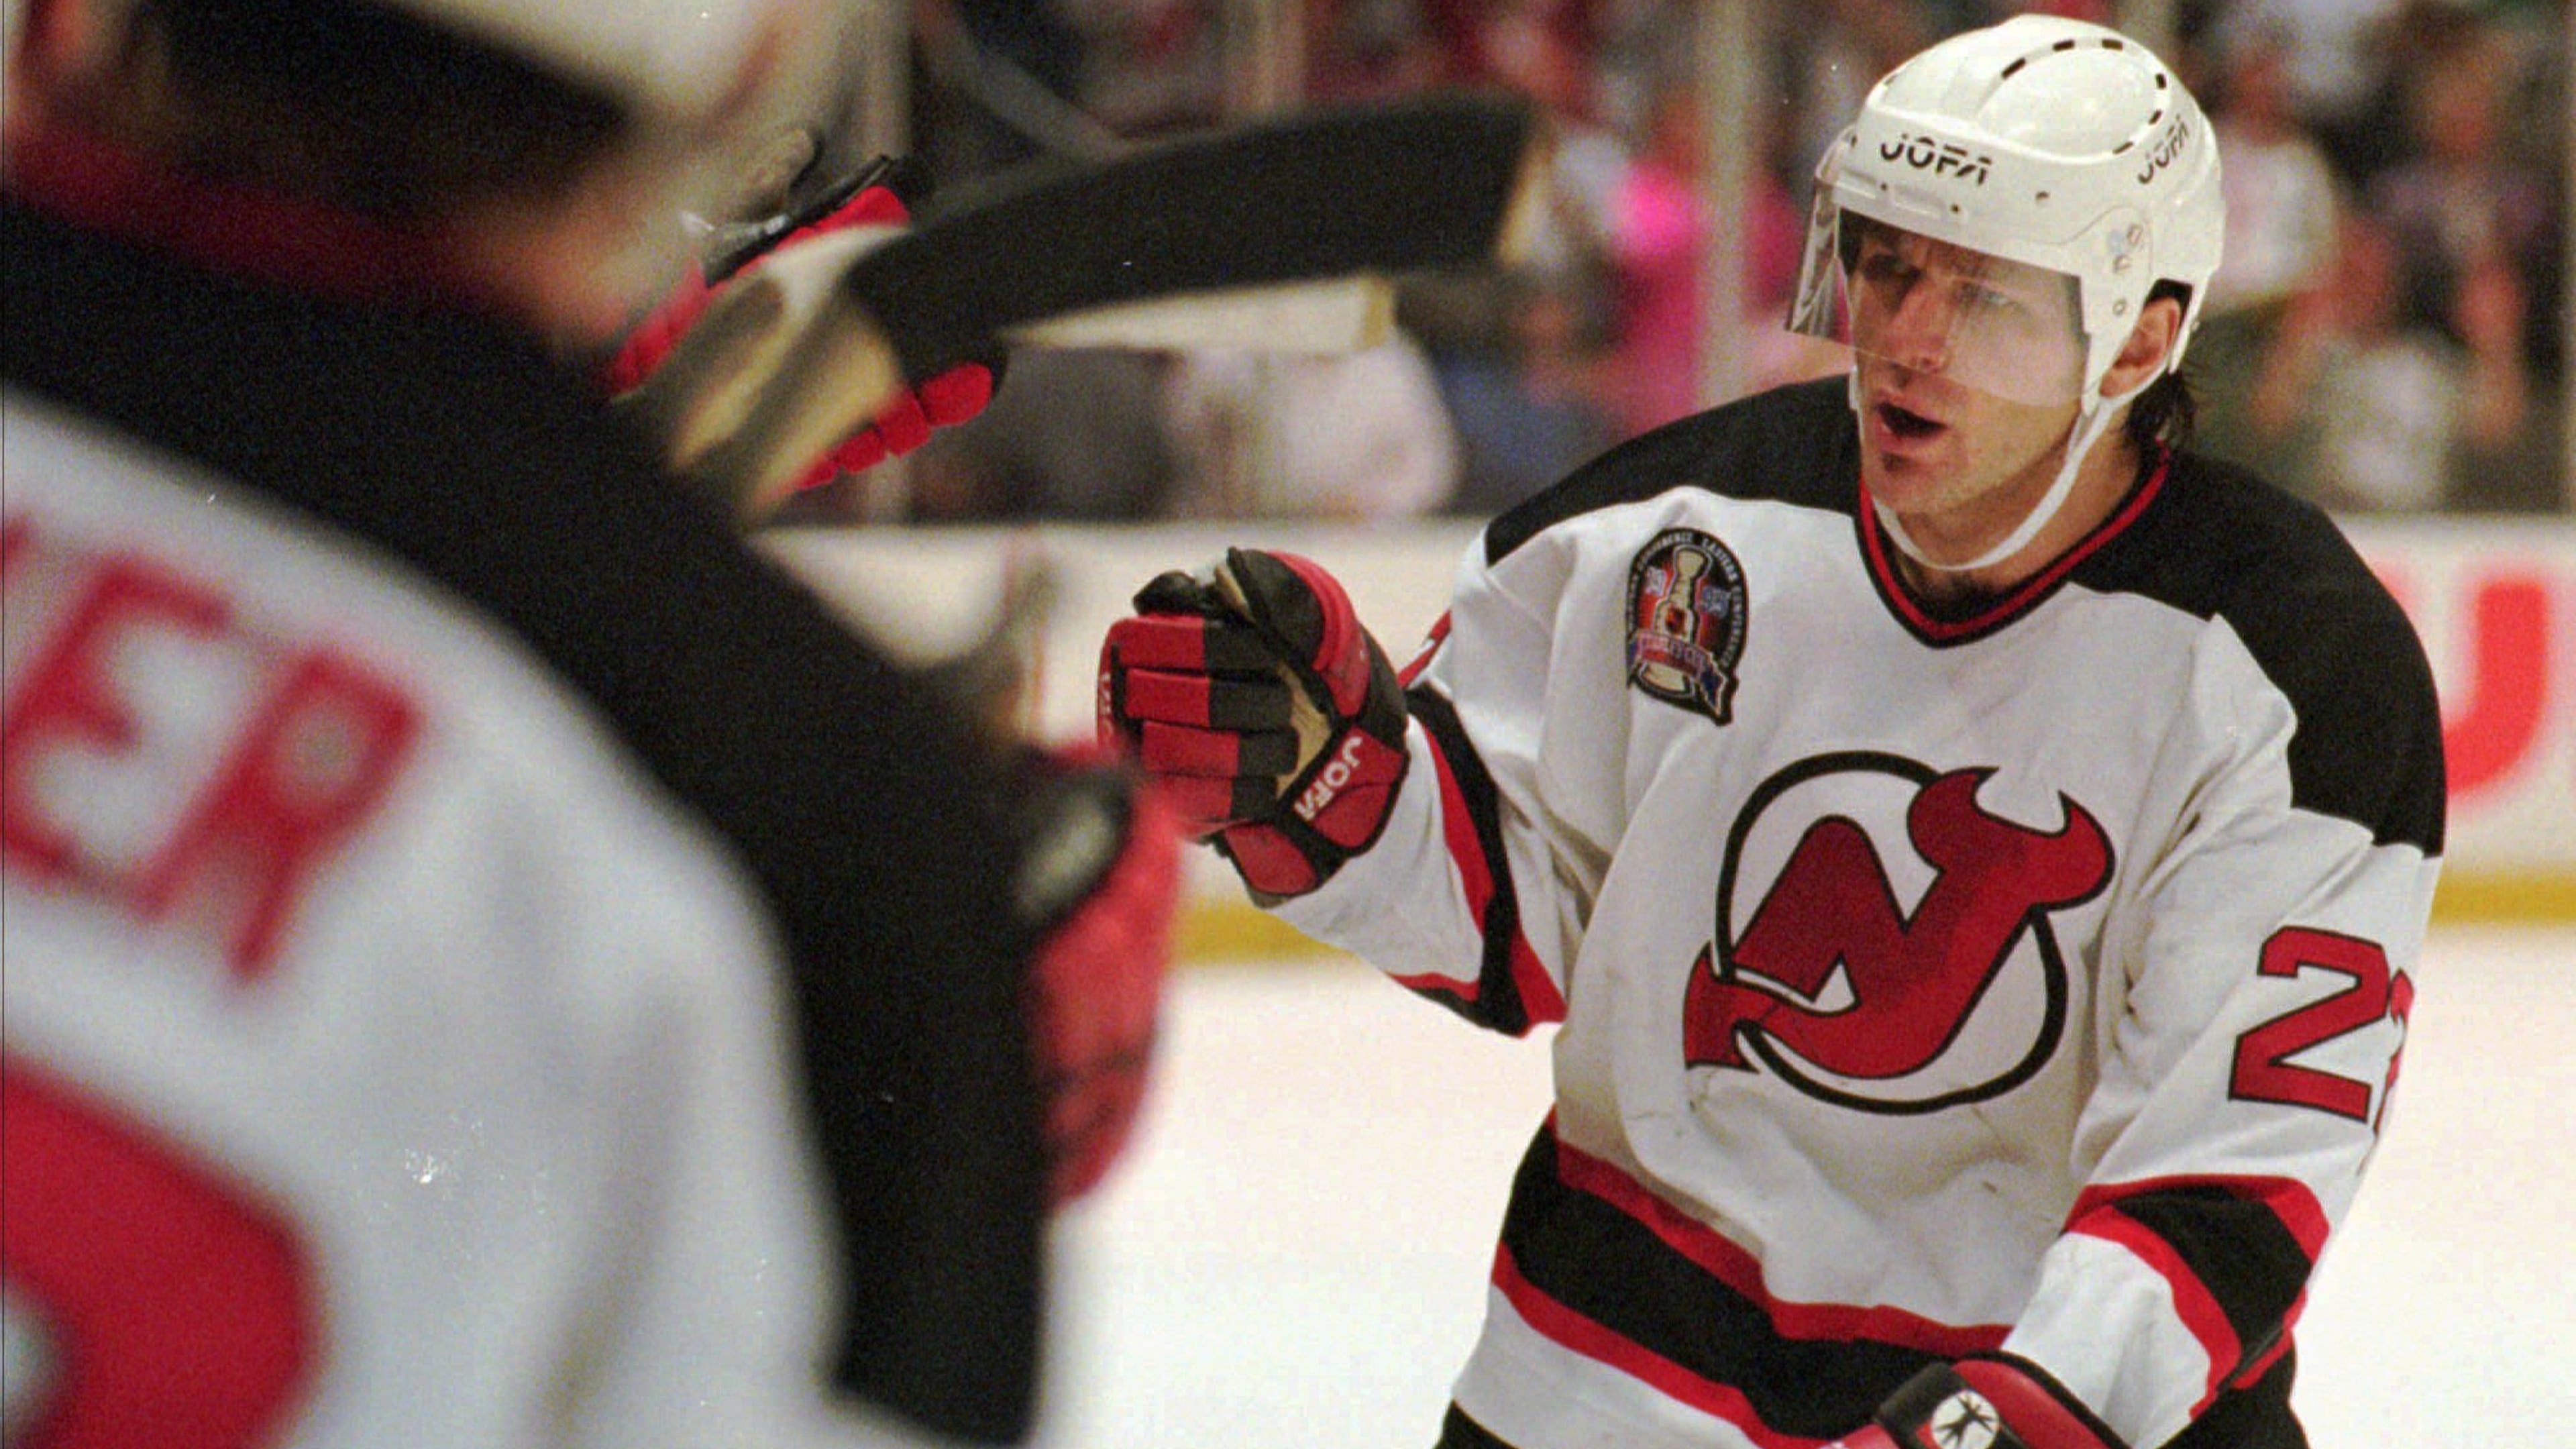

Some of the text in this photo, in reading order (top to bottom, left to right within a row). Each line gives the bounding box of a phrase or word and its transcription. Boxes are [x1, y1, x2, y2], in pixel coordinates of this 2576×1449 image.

[1880, 133, 1992, 185] JOFA
[2137, 113, 2190, 184] JOFA
[2, 513, 425, 983] ER
[1294, 736, 1363, 820] JOFA
[2228, 925, 2414, 1138] 2
